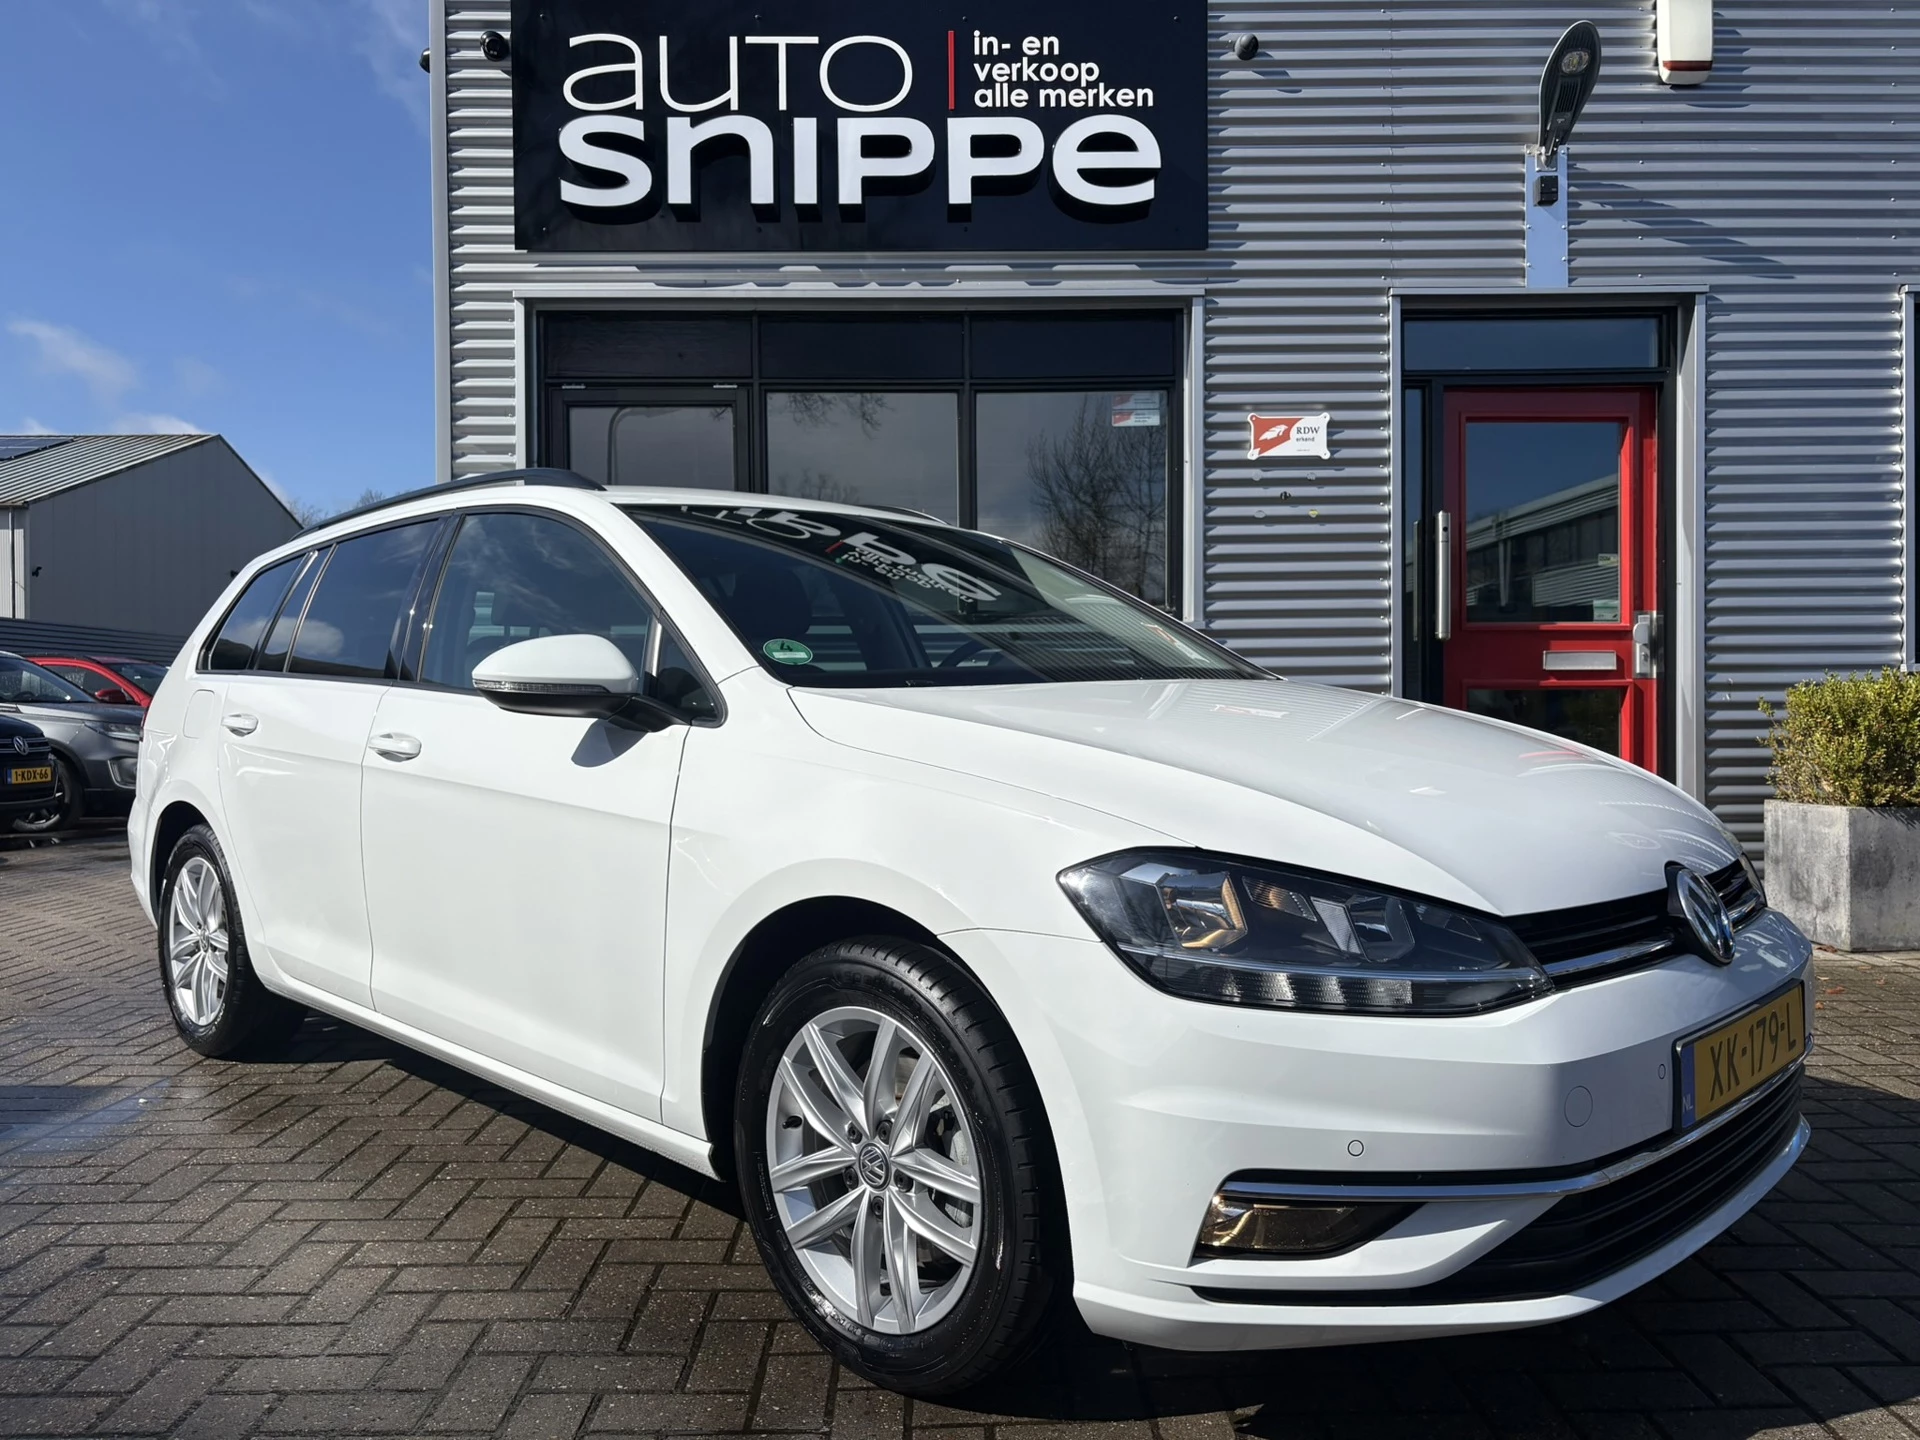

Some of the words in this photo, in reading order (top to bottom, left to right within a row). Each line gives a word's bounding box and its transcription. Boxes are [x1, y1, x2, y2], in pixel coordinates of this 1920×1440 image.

[973, 30, 1011, 56] in-
[1022, 36, 1059, 56] en
[973, 57, 1100, 87] verkoop
[974, 82, 1029, 108] alle
[1039, 82, 1154, 108] merken
[1296, 426, 1320, 435] RDW
[15, 769, 48, 781] 1-KDX-66
[1710, 1002, 1797, 1102] XK-179-L
[1682, 1093, 1694, 1113] NL
